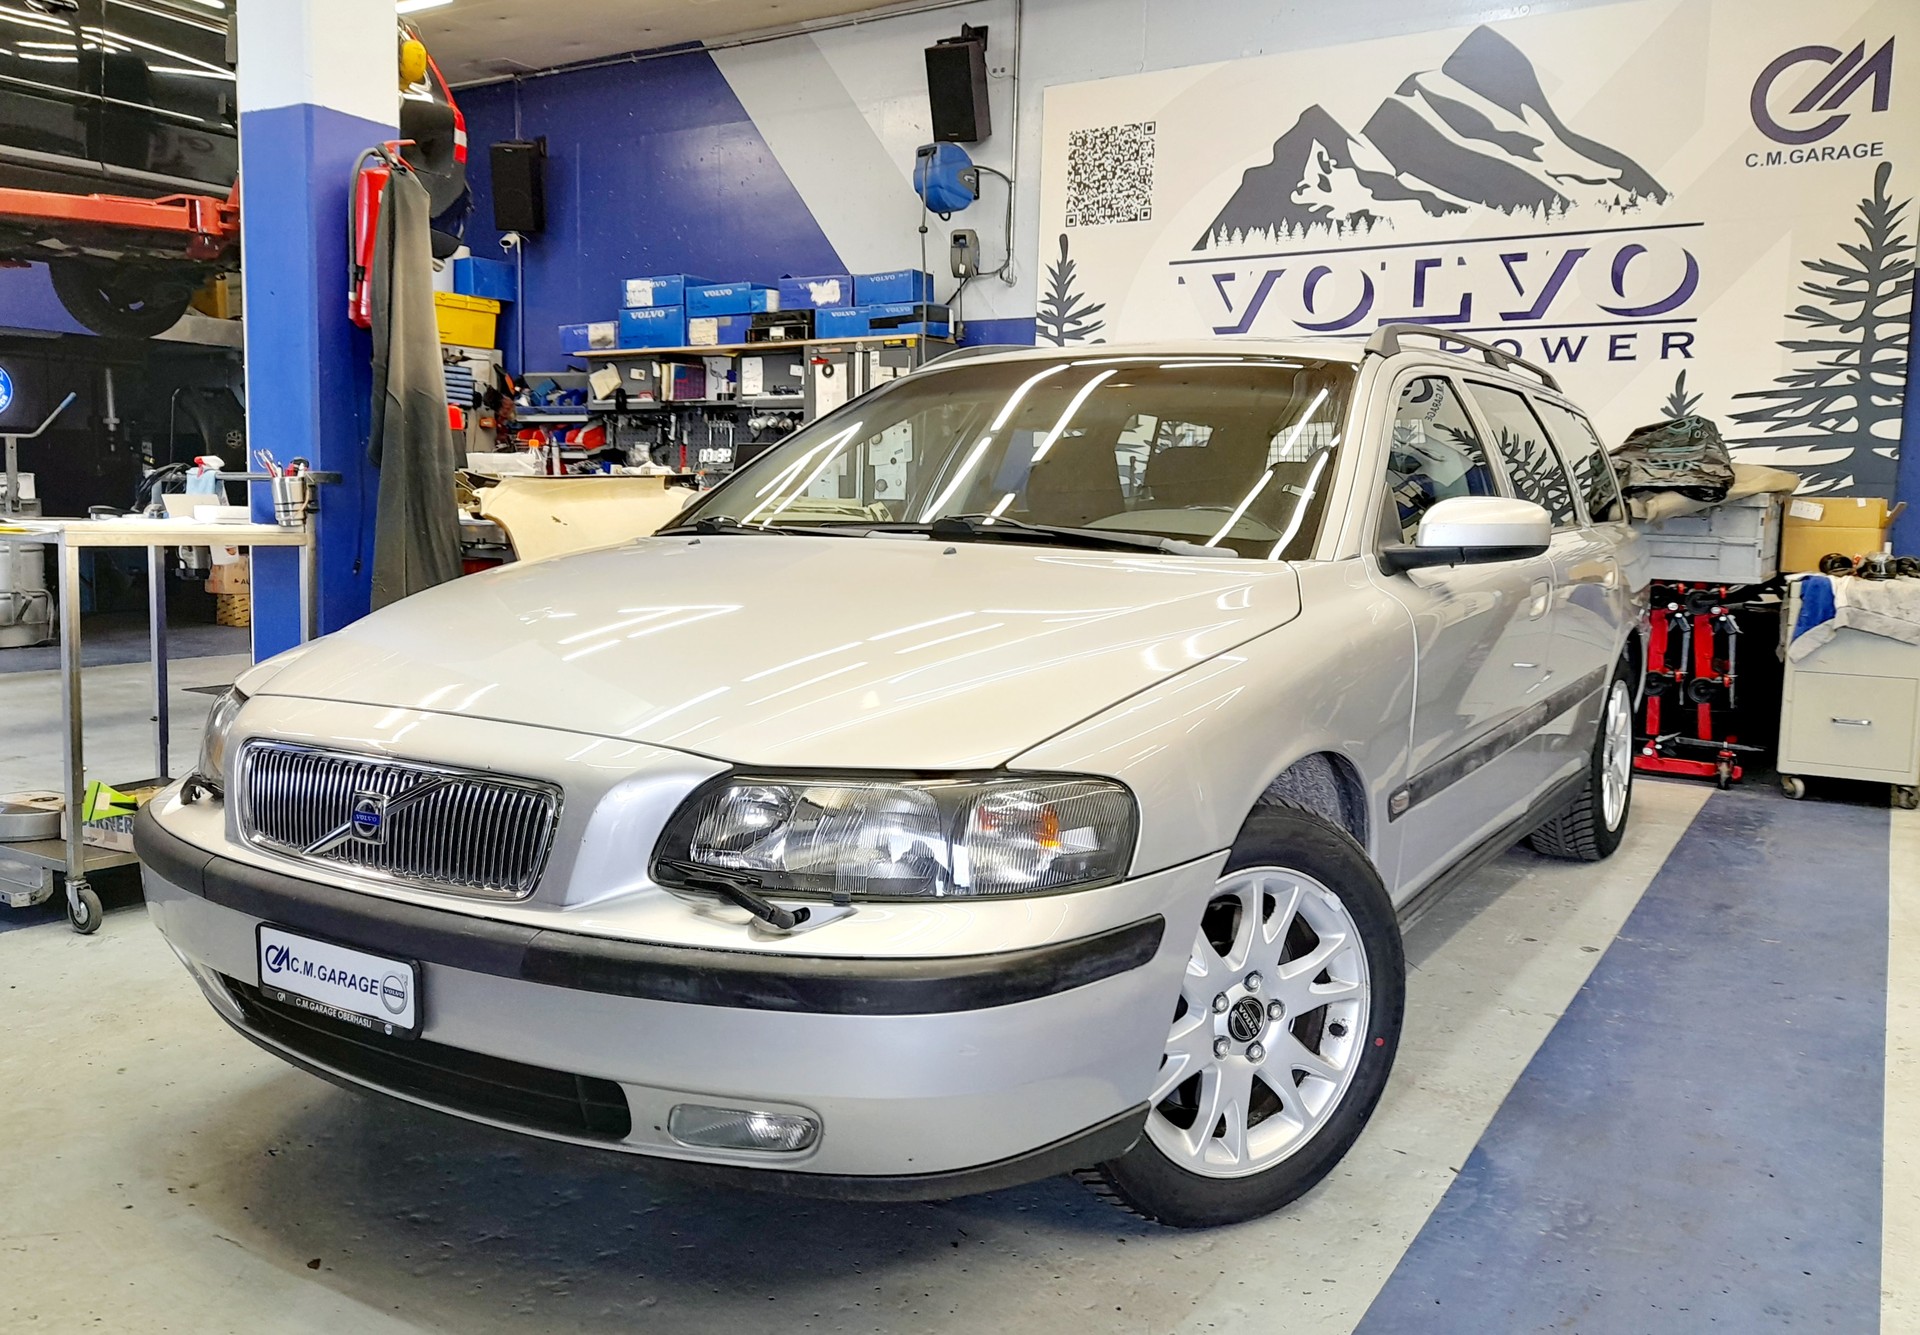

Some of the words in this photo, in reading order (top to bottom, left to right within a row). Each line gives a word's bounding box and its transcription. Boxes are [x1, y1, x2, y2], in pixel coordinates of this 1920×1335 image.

[1745, 142, 1884, 168] C.M.GARAGE
[869, 274, 895, 283] VOLVO
[703, 289, 732, 297] VOLVO
[1178, 244, 1699, 335] VOLVO
[630, 310, 665, 319] VOLVO
[290, 957, 379, 996] C.M.GARAGE
[384, 987, 404, 998] VOLVO
[1239, 1004, 1257, 1035] VOLVO
